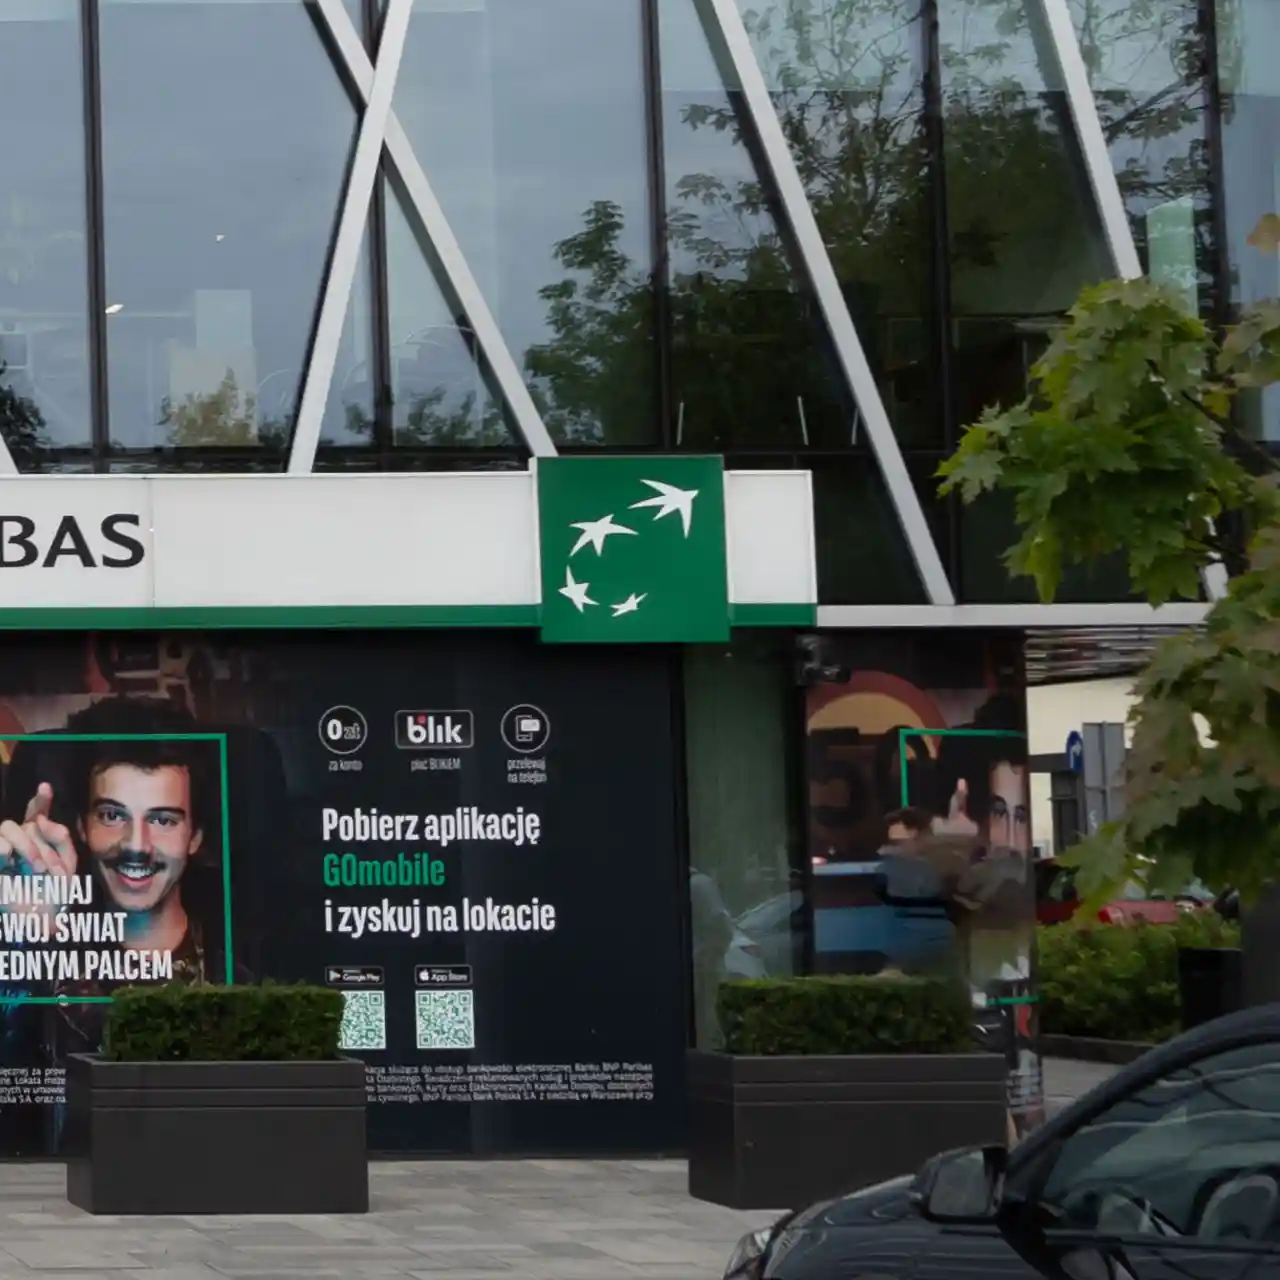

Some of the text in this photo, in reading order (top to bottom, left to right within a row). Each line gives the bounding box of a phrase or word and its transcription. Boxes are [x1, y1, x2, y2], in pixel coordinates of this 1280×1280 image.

[326, 718, 343, 741] 0
[406, 713, 463, 744] blik
[322, 806, 541, 848] Pobierz aplikację
[322, 851, 446, 888] GOmobile
[55, 905, 128, 943] ŚWIAT
[324, 896, 558, 940] i zyskuj na lokacie
[84, 949, 173, 981] PALCEM
